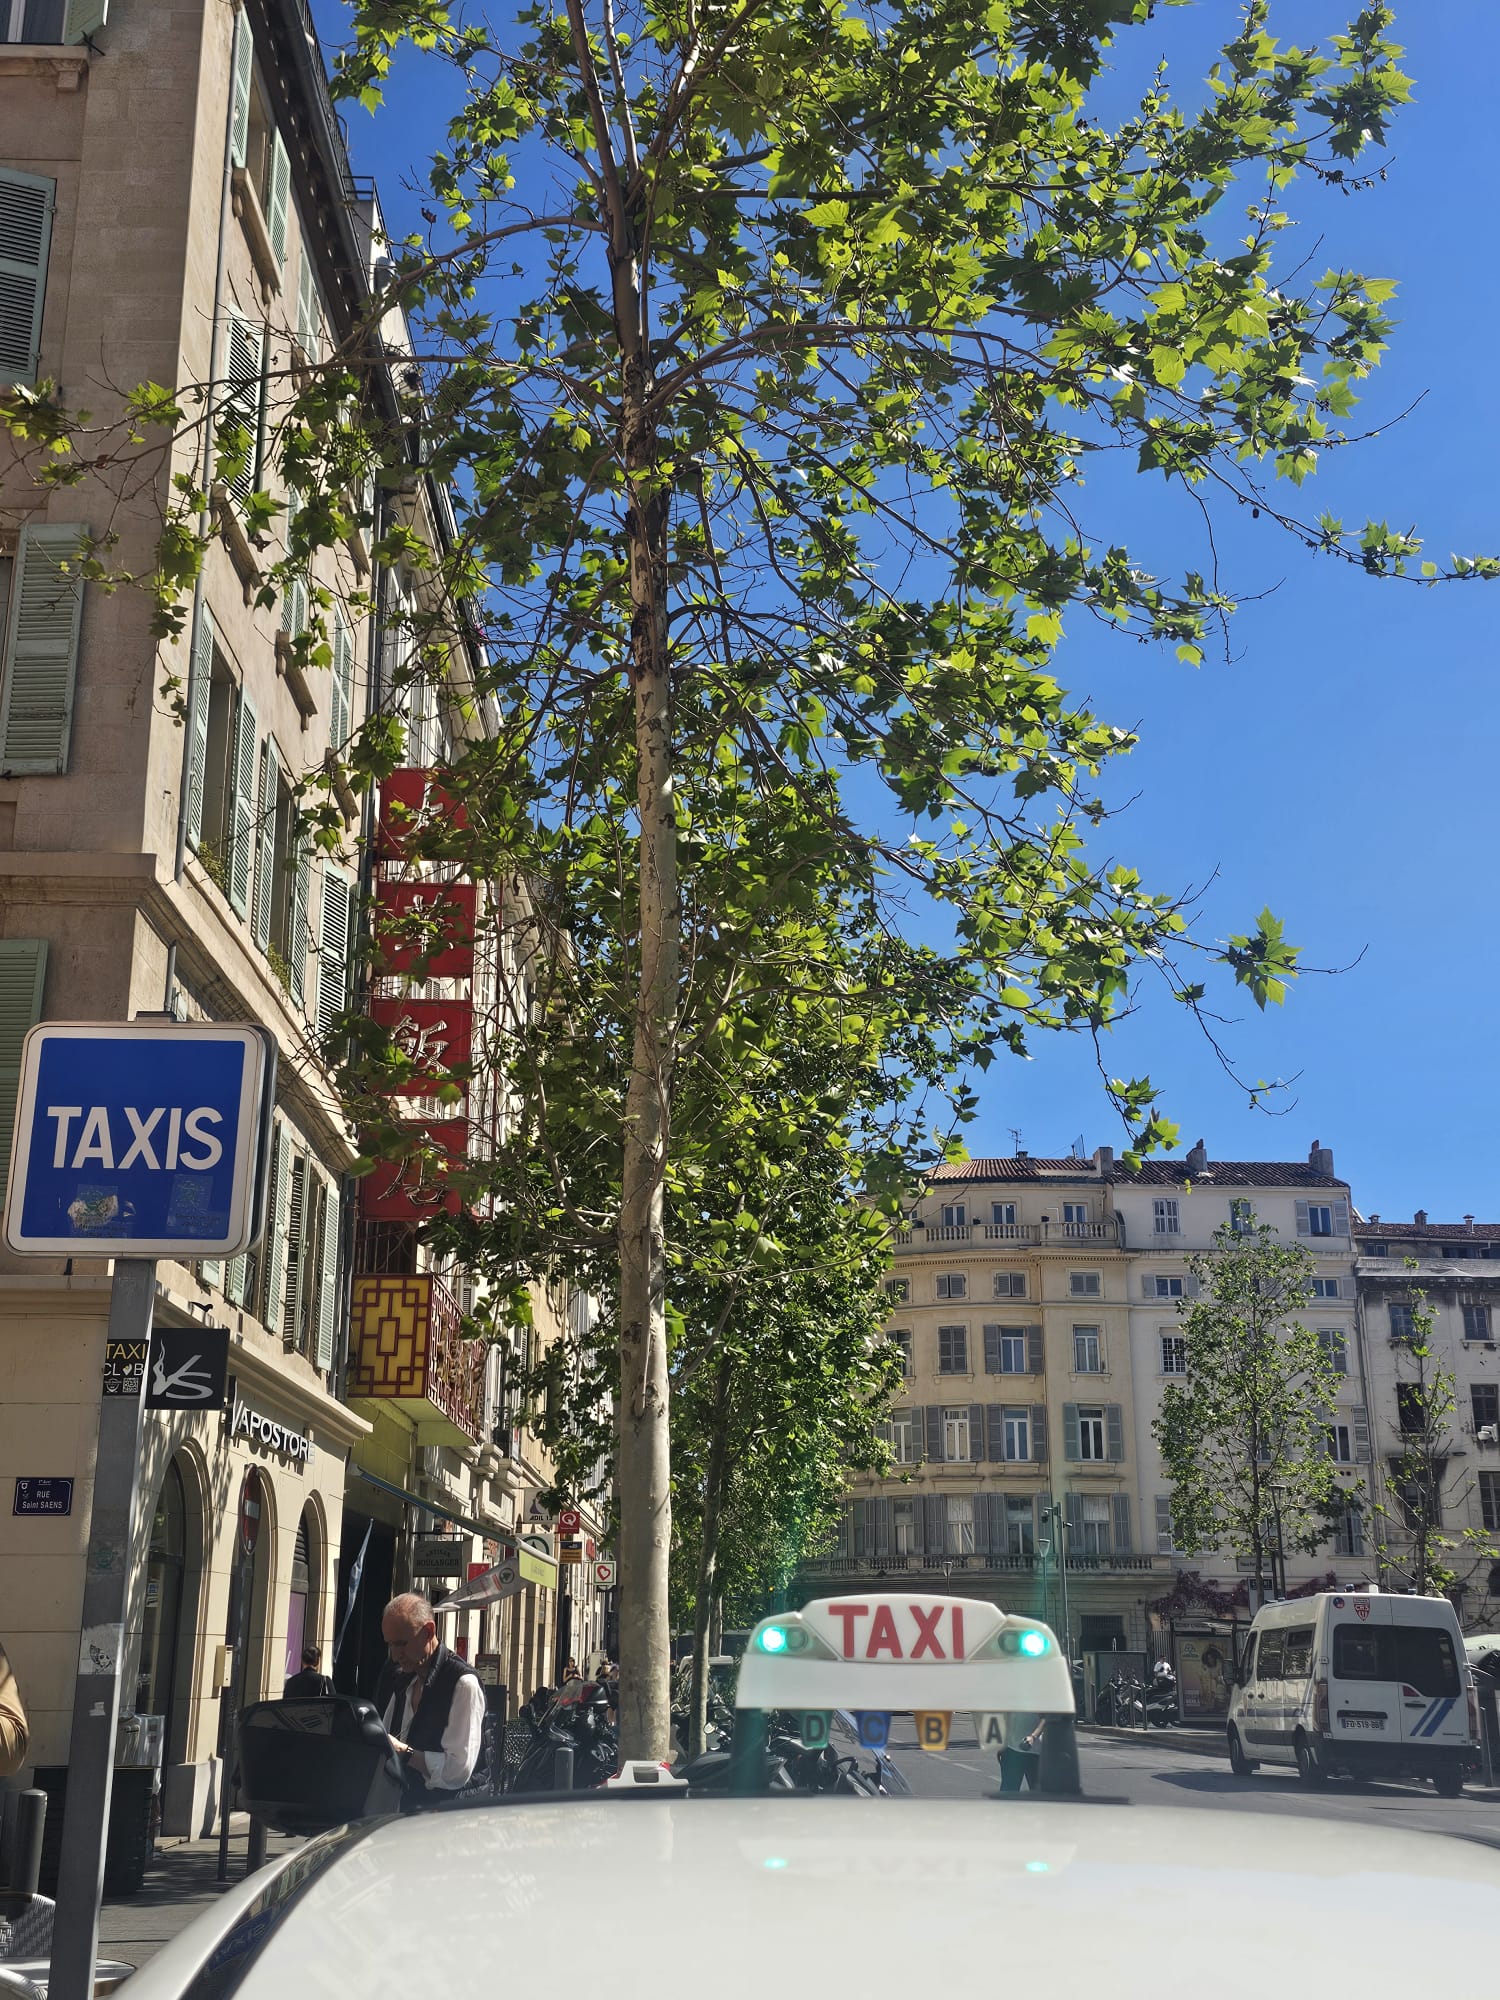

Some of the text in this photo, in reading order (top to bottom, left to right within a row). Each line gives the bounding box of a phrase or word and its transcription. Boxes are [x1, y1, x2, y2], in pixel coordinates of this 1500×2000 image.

[47, 1106, 223, 1170] TAXIS
[106, 1343, 146, 1360] TAXI
[22, 1501, 63, 1509] Saint SAENS
[36, 1490, 51, 1498] RUE
[828, 1604, 965, 1660] TAXI
[806, 1715, 1003, 1745] D C B A
